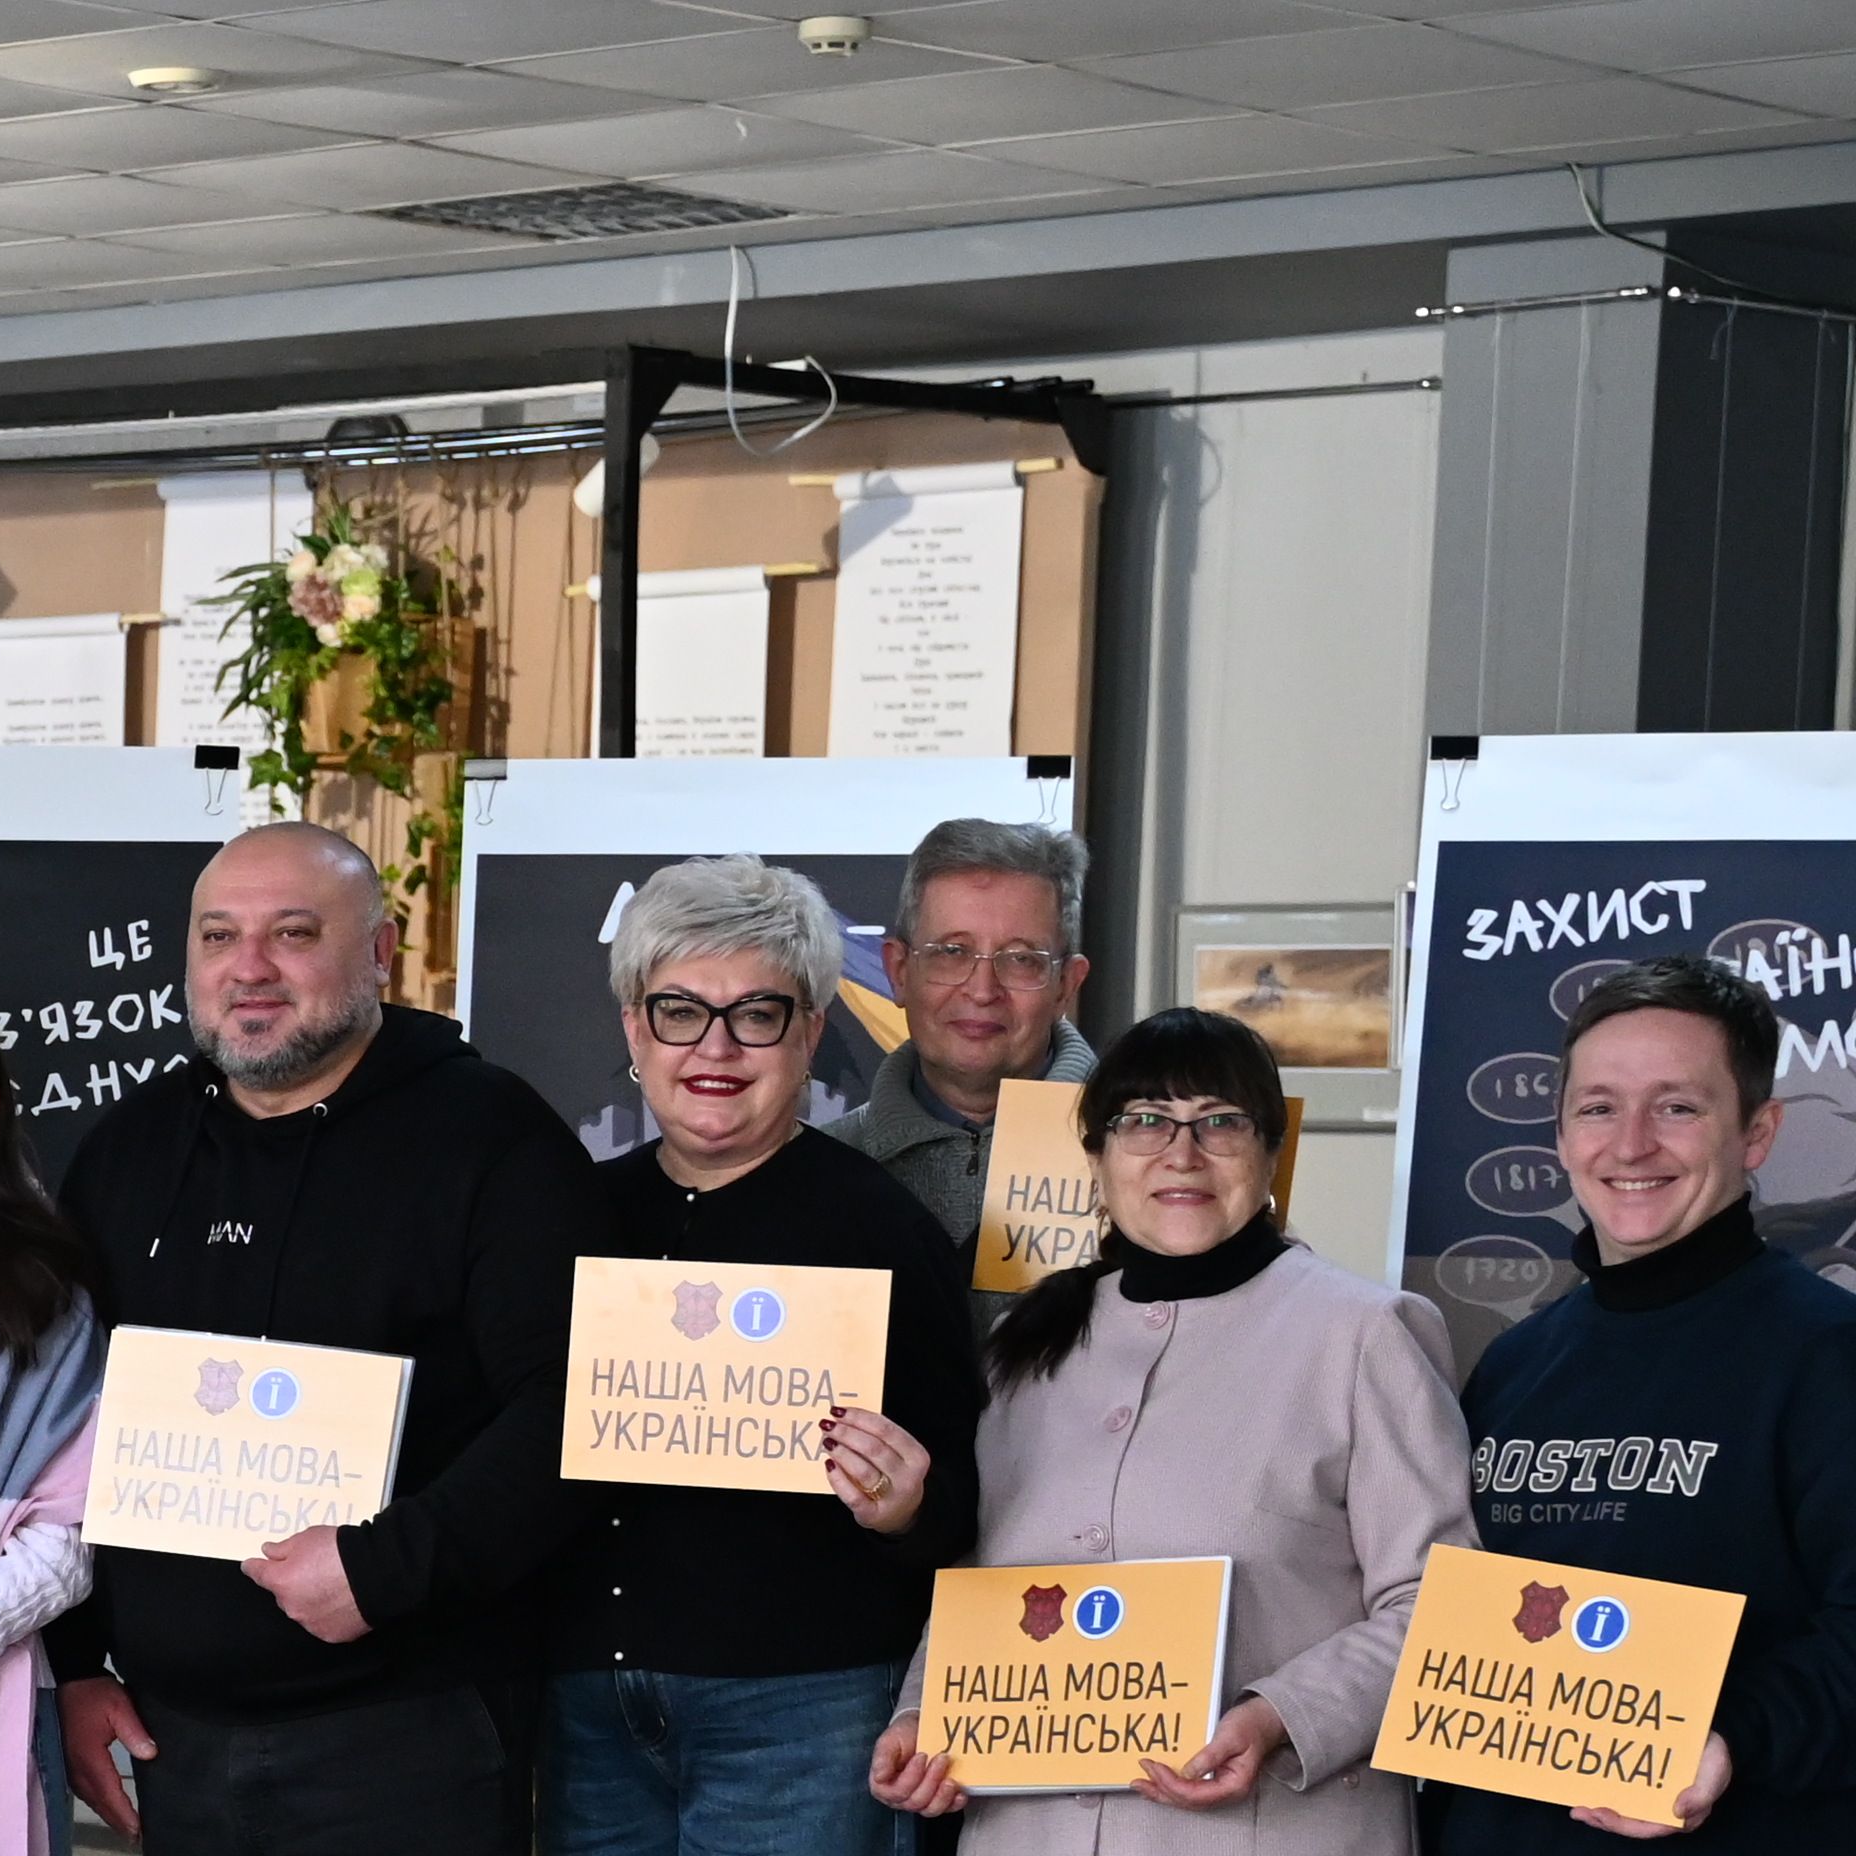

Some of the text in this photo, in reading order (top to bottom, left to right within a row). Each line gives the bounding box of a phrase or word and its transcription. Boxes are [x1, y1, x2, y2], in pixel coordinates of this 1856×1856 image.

[1462, 879, 1707, 961] ЗАХИСТ
[88, 919, 153, 971] ЦЕ
[1495, 1072, 1559, 1099] 186
[1006, 1174, 1098, 1217] НАШ
[1001, 1221, 1109, 1266] УКРА
[590, 1358, 708, 1402] НАША
[113, 1427, 223, 1476] НАША
[1472, 1436, 1719, 1497] BOSTON
[1491, 1501, 1629, 1524] BIG CITY LIFE
[943, 1664, 1050, 1703] НАША
[1417, 1649, 1536, 1708] НАША
[941, 1705, 1183, 1755] УКРАЇНСЬКА!
[1405, 1700, 1673, 1790] УКРАЇНСЬКА!
